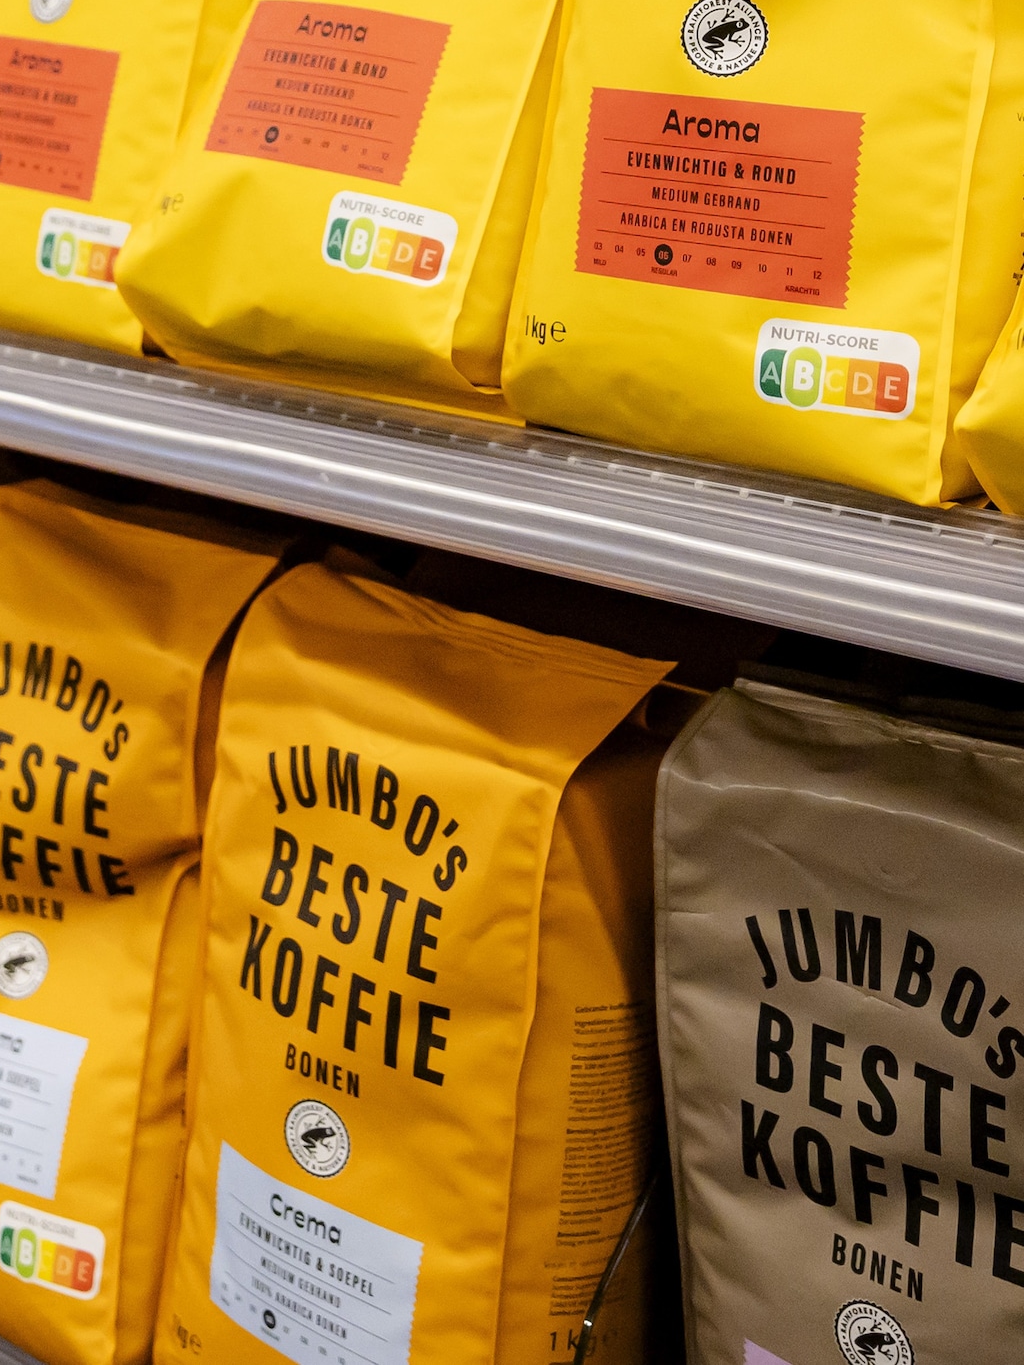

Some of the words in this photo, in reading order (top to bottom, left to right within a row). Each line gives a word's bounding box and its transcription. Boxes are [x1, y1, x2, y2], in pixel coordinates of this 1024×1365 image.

[297, 14, 368, 43] Aroma
[688, 0, 732, 34] RAINFOREST
[735, 2, 761, 41] ALLIANCE
[353, 61, 387, 80] ROND
[689, 42, 714, 69] PEOPLE
[726, 49, 757, 70] NATURE
[662, 108, 761, 143] Aroma
[627, 151, 727, 177] EVENWICHTIG
[734, 163, 745, 179] &
[752, 165, 796, 185] ROND
[339, 198, 424, 226] NUTRI-SCORE
[652, 186, 699, 204] MEDIUM
[704, 193, 761, 212] GEBRAND
[620, 211, 667, 230] ARABICA
[672, 218, 686, 232] EN
[691, 221, 745, 241] ROBUSTA
[750, 228, 793, 246] BONEN
[350, 227, 369, 255] B
[394, 242, 414, 262] D
[420, 248, 437, 271] E
[731, 260, 742, 270] 09
[758, 263, 767, 272] 10
[813, 270, 822, 280] 12
[785, 285, 820, 296] KRACHTIG
[771, 326, 880, 351] NUTRI-SCORE
[761, 364, 781, 385] A
[793, 360, 814, 391] B
[824, 368, 845, 392] C
[852, 372, 873, 396] D
[884, 376, 902, 401] E
[261, 826, 443, 984] BESTE
[240, 914, 451, 1086] KOFFIE
[285, 1043, 360, 1098] BONEN
[755, 1002, 1011, 1177] BESTE
[741, 1099, 1024, 1288] KOFFIE
[270, 1193, 342, 1246] Crema
[240, 1212, 311, 1266] EVENWICHTIG
[316, 1257, 323, 1272] &
[329, 1263, 374, 1297] SOEPEL
[832, 1233, 923, 1302] BONEN
[840, 1307, 878, 1334] RAINFOREST
[881, 1316, 909, 1360] ALLIANCE
